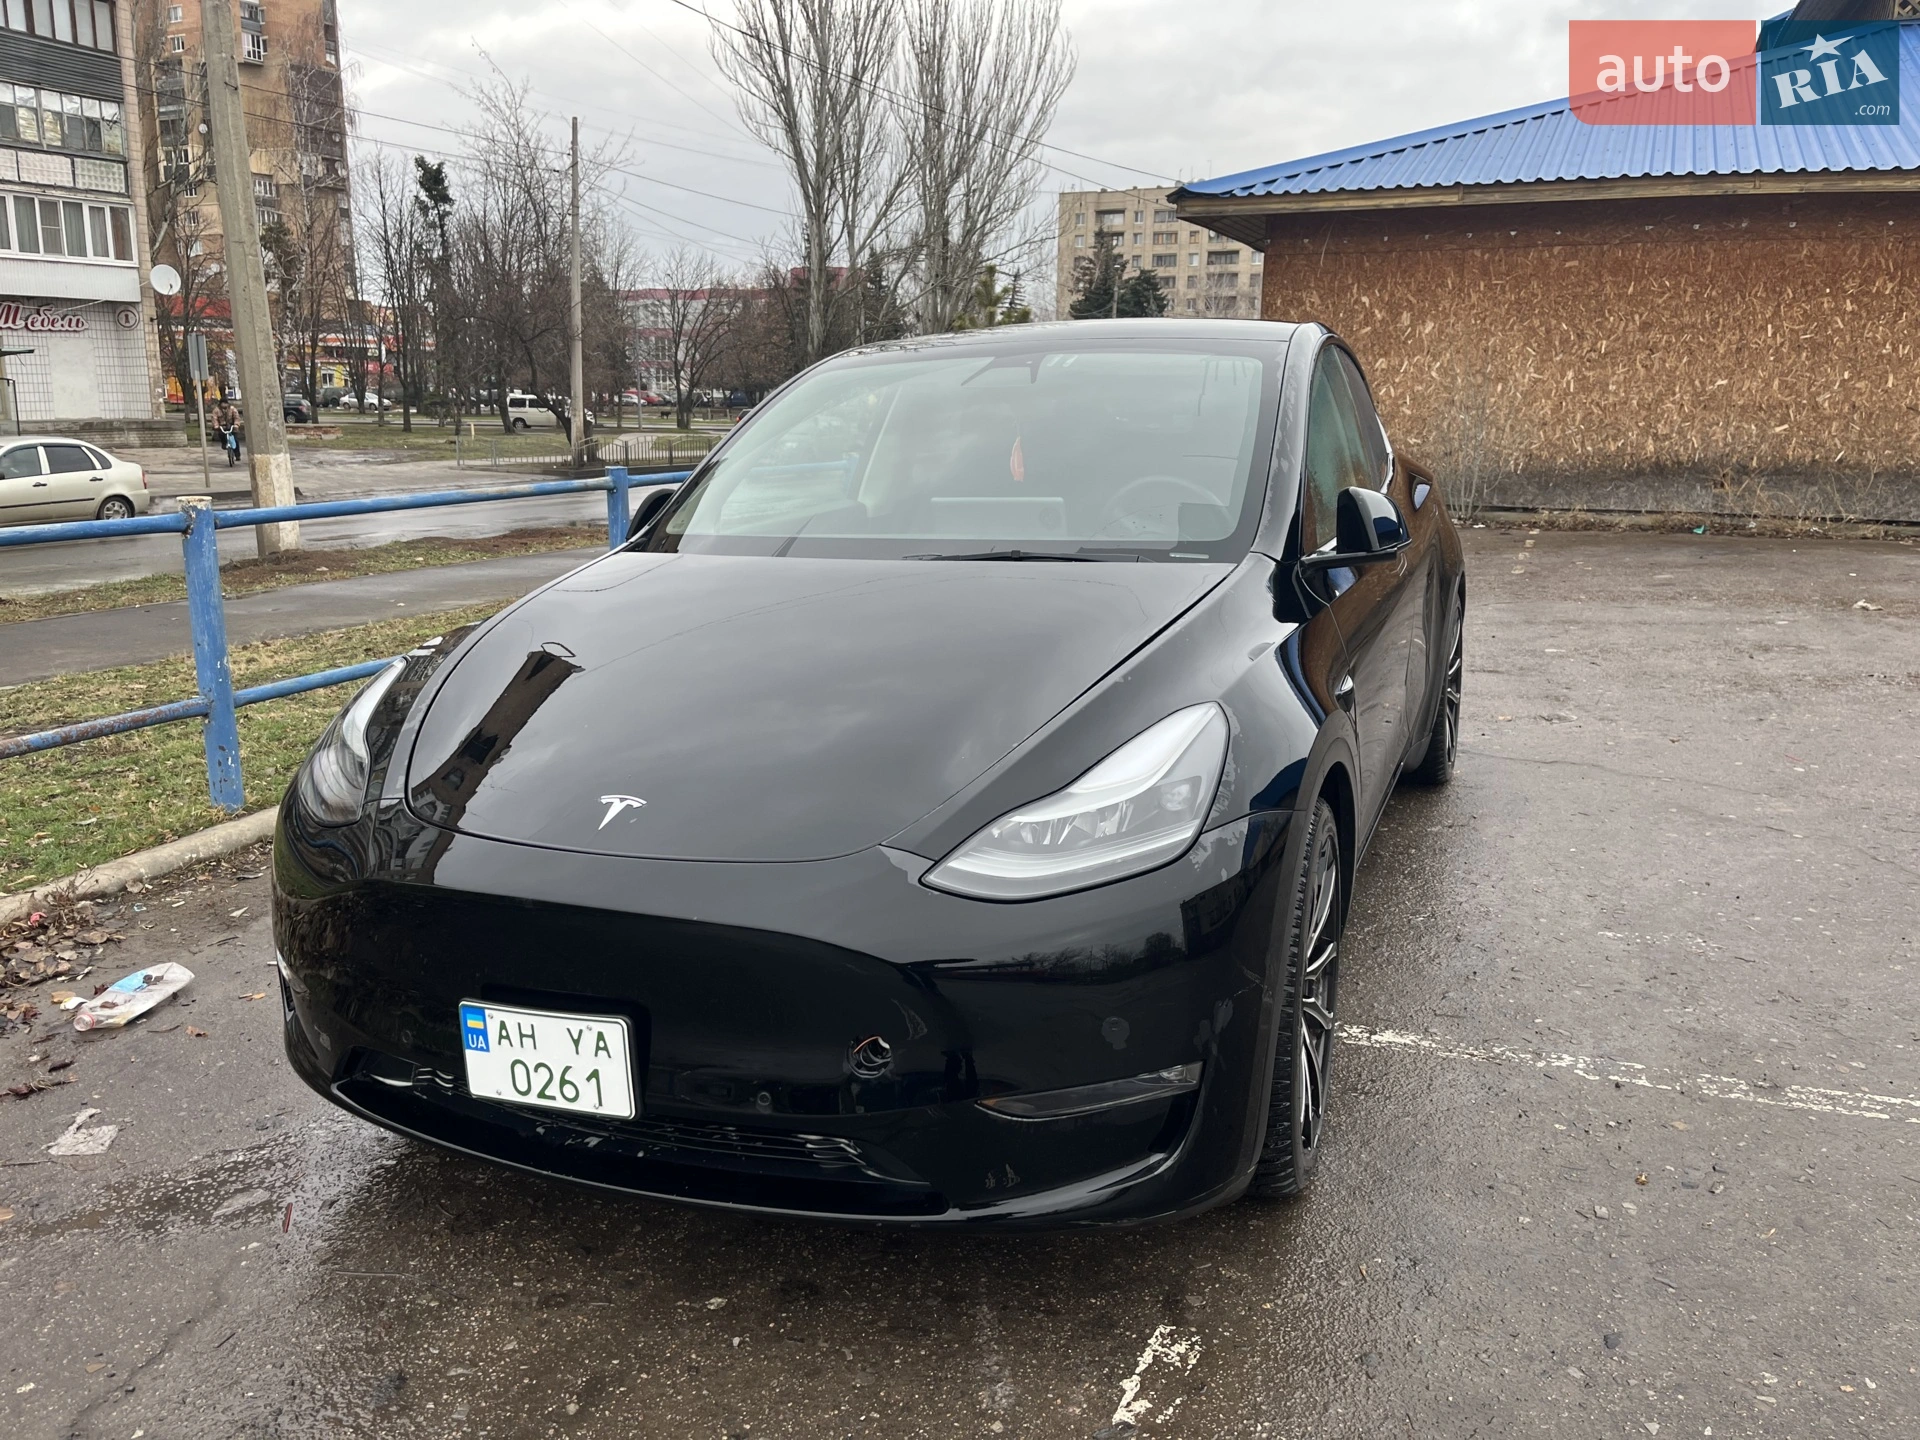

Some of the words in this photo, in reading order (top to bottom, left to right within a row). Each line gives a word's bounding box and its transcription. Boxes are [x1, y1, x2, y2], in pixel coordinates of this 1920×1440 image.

[468, 1033, 487, 1050] UA
[497, 1020, 538, 1050] AH
[566, 1027, 612, 1059] YA
[510, 1058, 603, 1108] 0261
